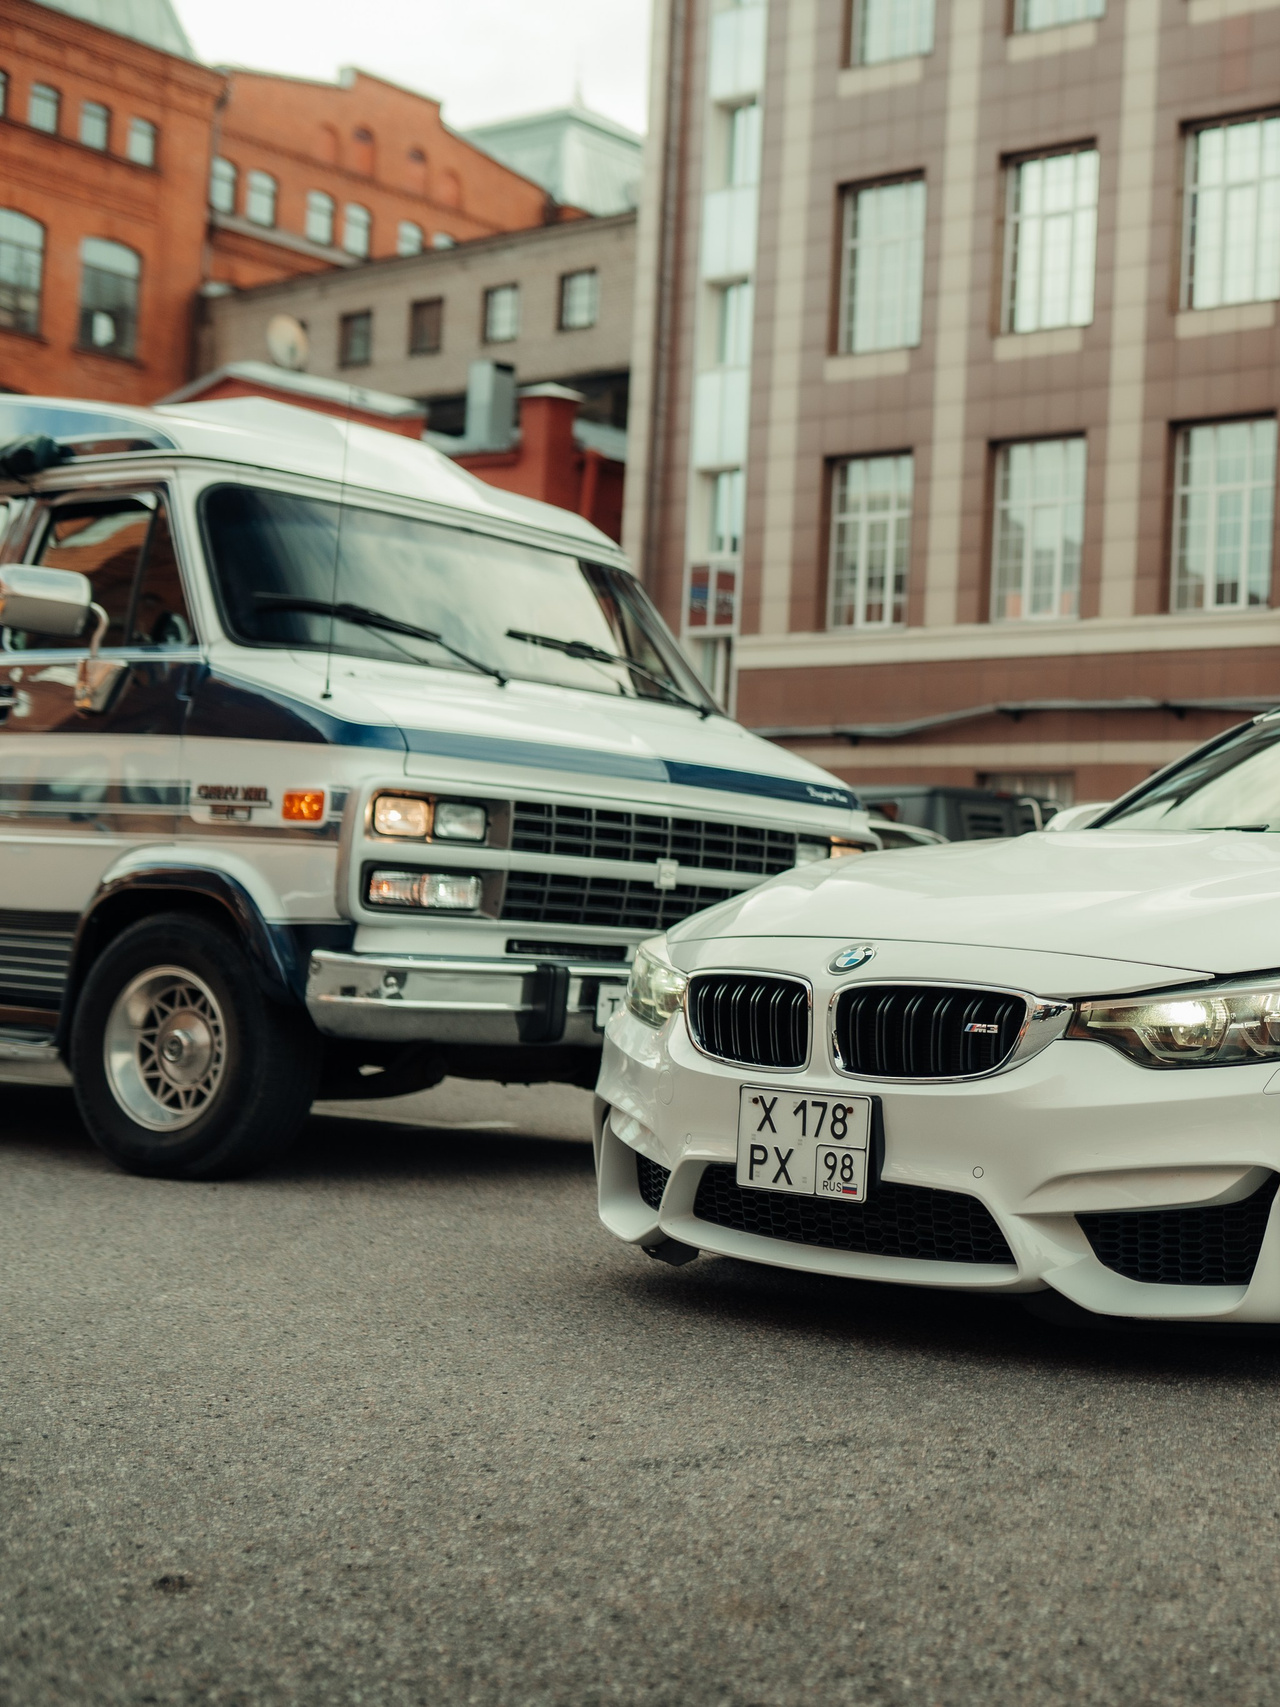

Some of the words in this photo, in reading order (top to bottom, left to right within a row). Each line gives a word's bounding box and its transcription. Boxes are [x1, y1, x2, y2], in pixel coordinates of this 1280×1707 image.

[975, 1023, 998, 1033] M3
[757, 1095, 778, 1133] X
[793, 1100, 848, 1140] 178
[749, 1143, 794, 1185] PX
[824, 1151, 854, 1182] 98
[822, 1180, 842, 1193] RUS
